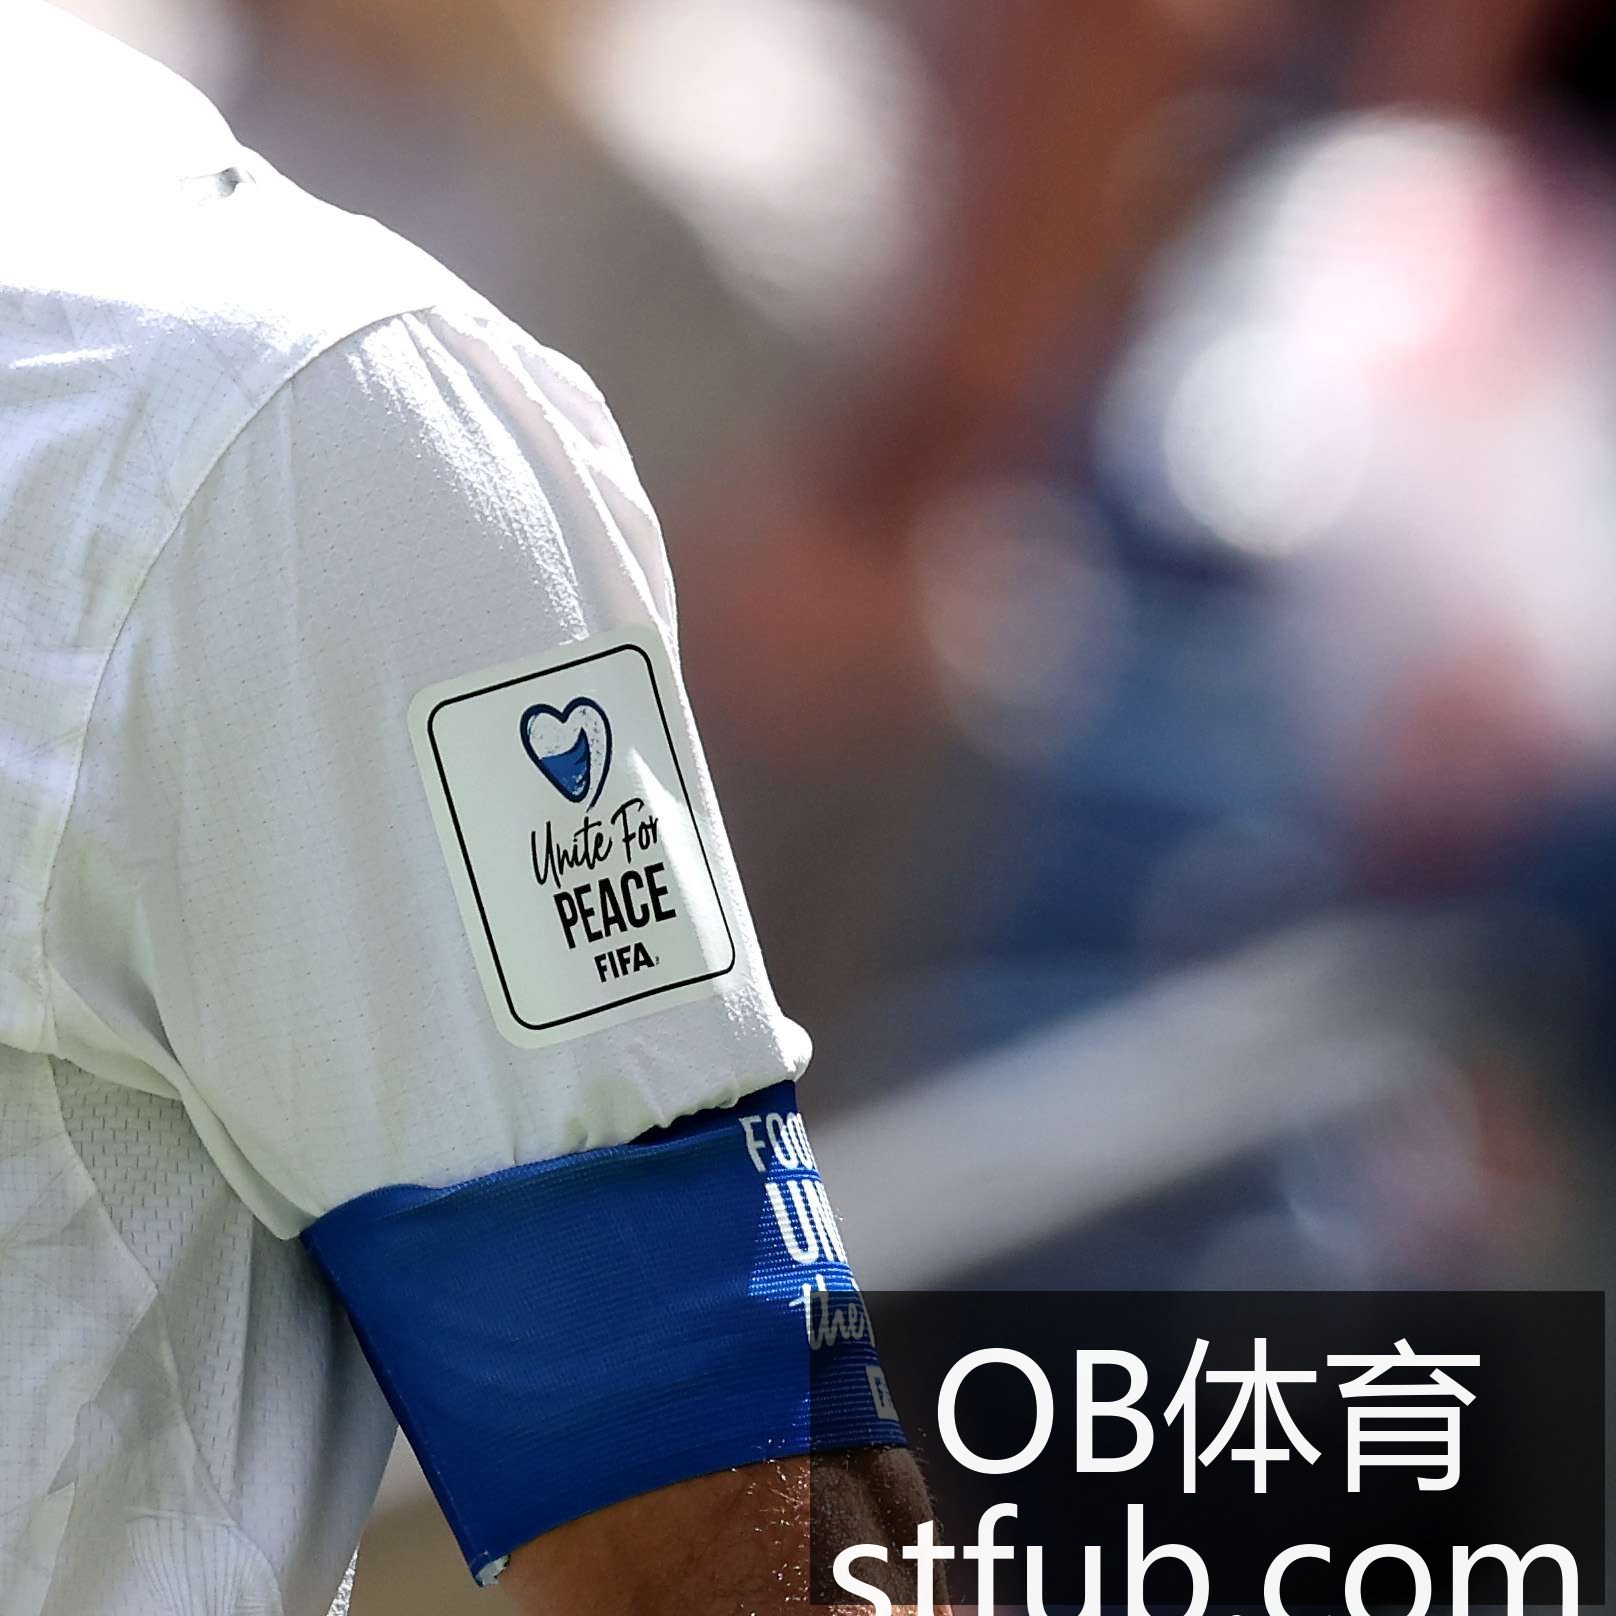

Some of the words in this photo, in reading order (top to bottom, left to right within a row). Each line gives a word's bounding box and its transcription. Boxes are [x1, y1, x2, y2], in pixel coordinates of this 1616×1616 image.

[530, 815, 613, 890] Unite
[610, 797, 659, 865] For
[553, 862, 676, 949] PEACE
[594, 941, 655, 983] FIFA
[738, 1112, 818, 1174] FOO
[764, 1179, 849, 1264] UN
